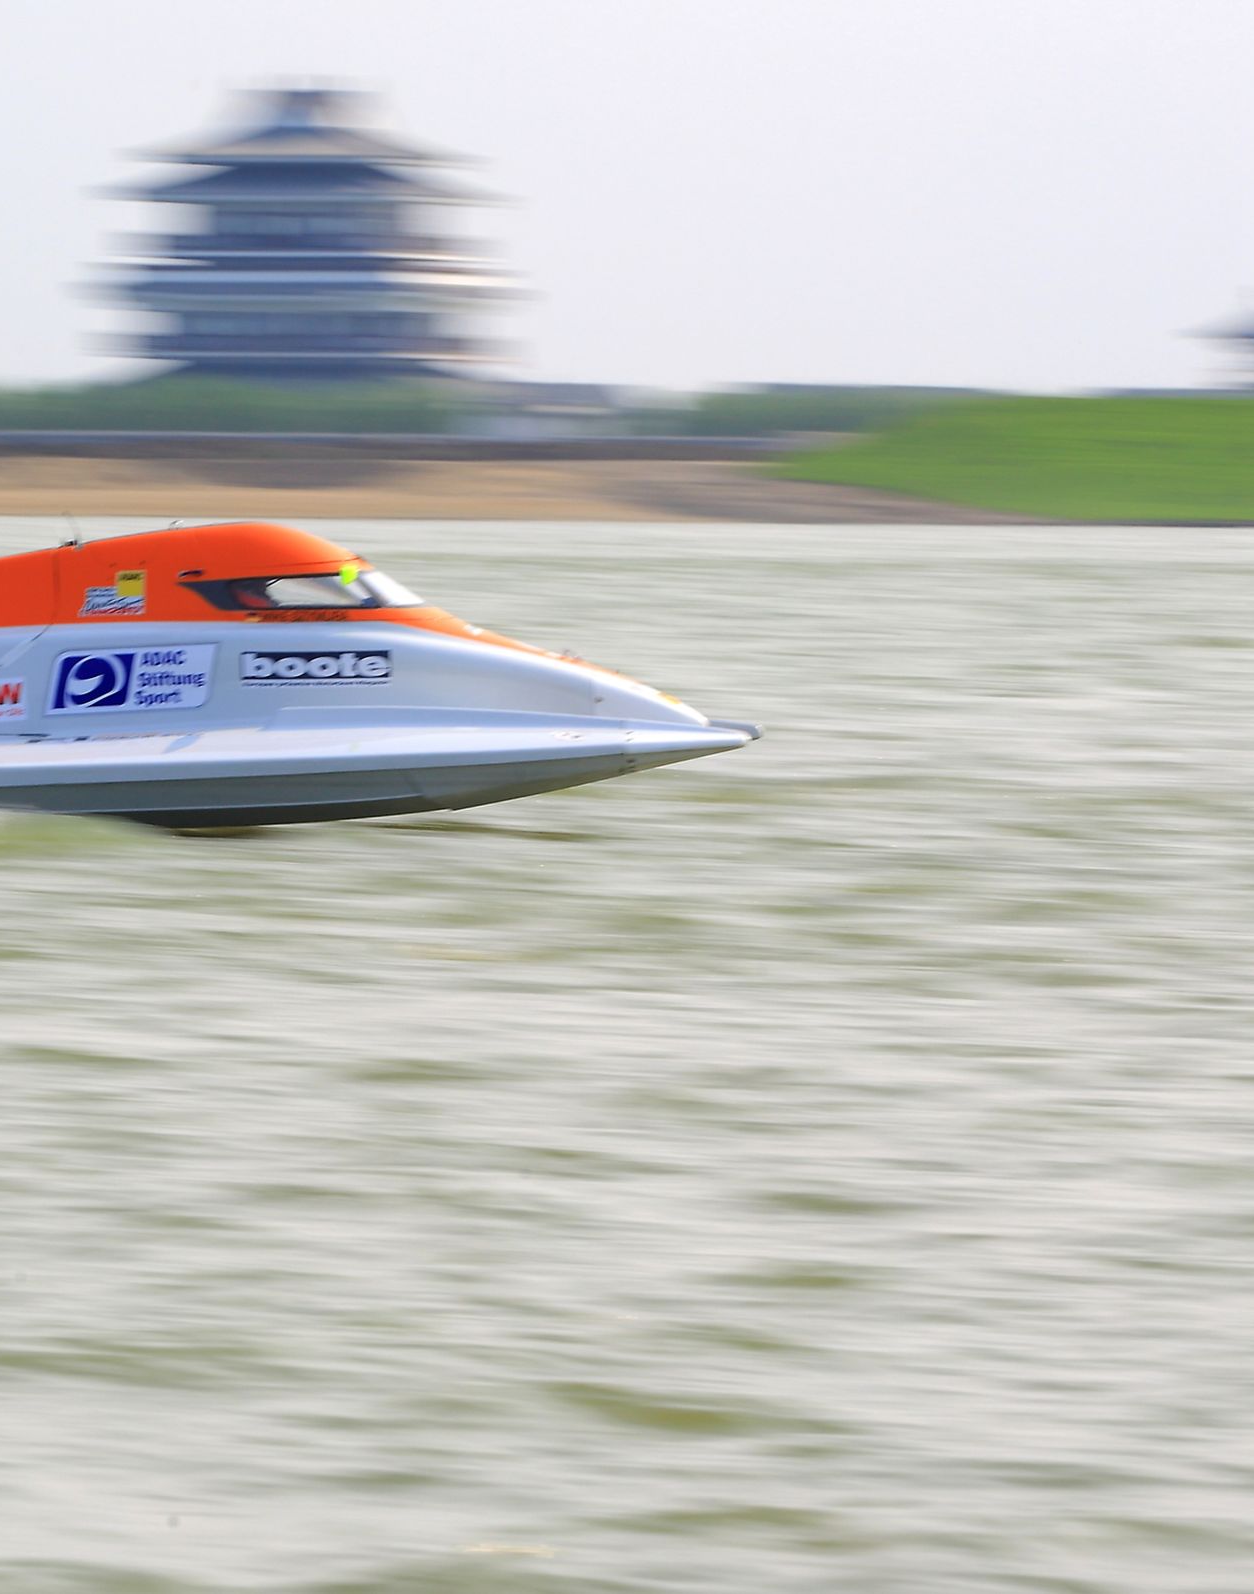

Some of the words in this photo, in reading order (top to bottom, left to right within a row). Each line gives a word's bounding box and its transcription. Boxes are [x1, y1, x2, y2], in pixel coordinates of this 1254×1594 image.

[141, 650, 186, 667] ADAC
[240, 652, 392, 679] boote
[138, 671, 205, 687] Stiftung
[134, 688, 182, 707] Sport
